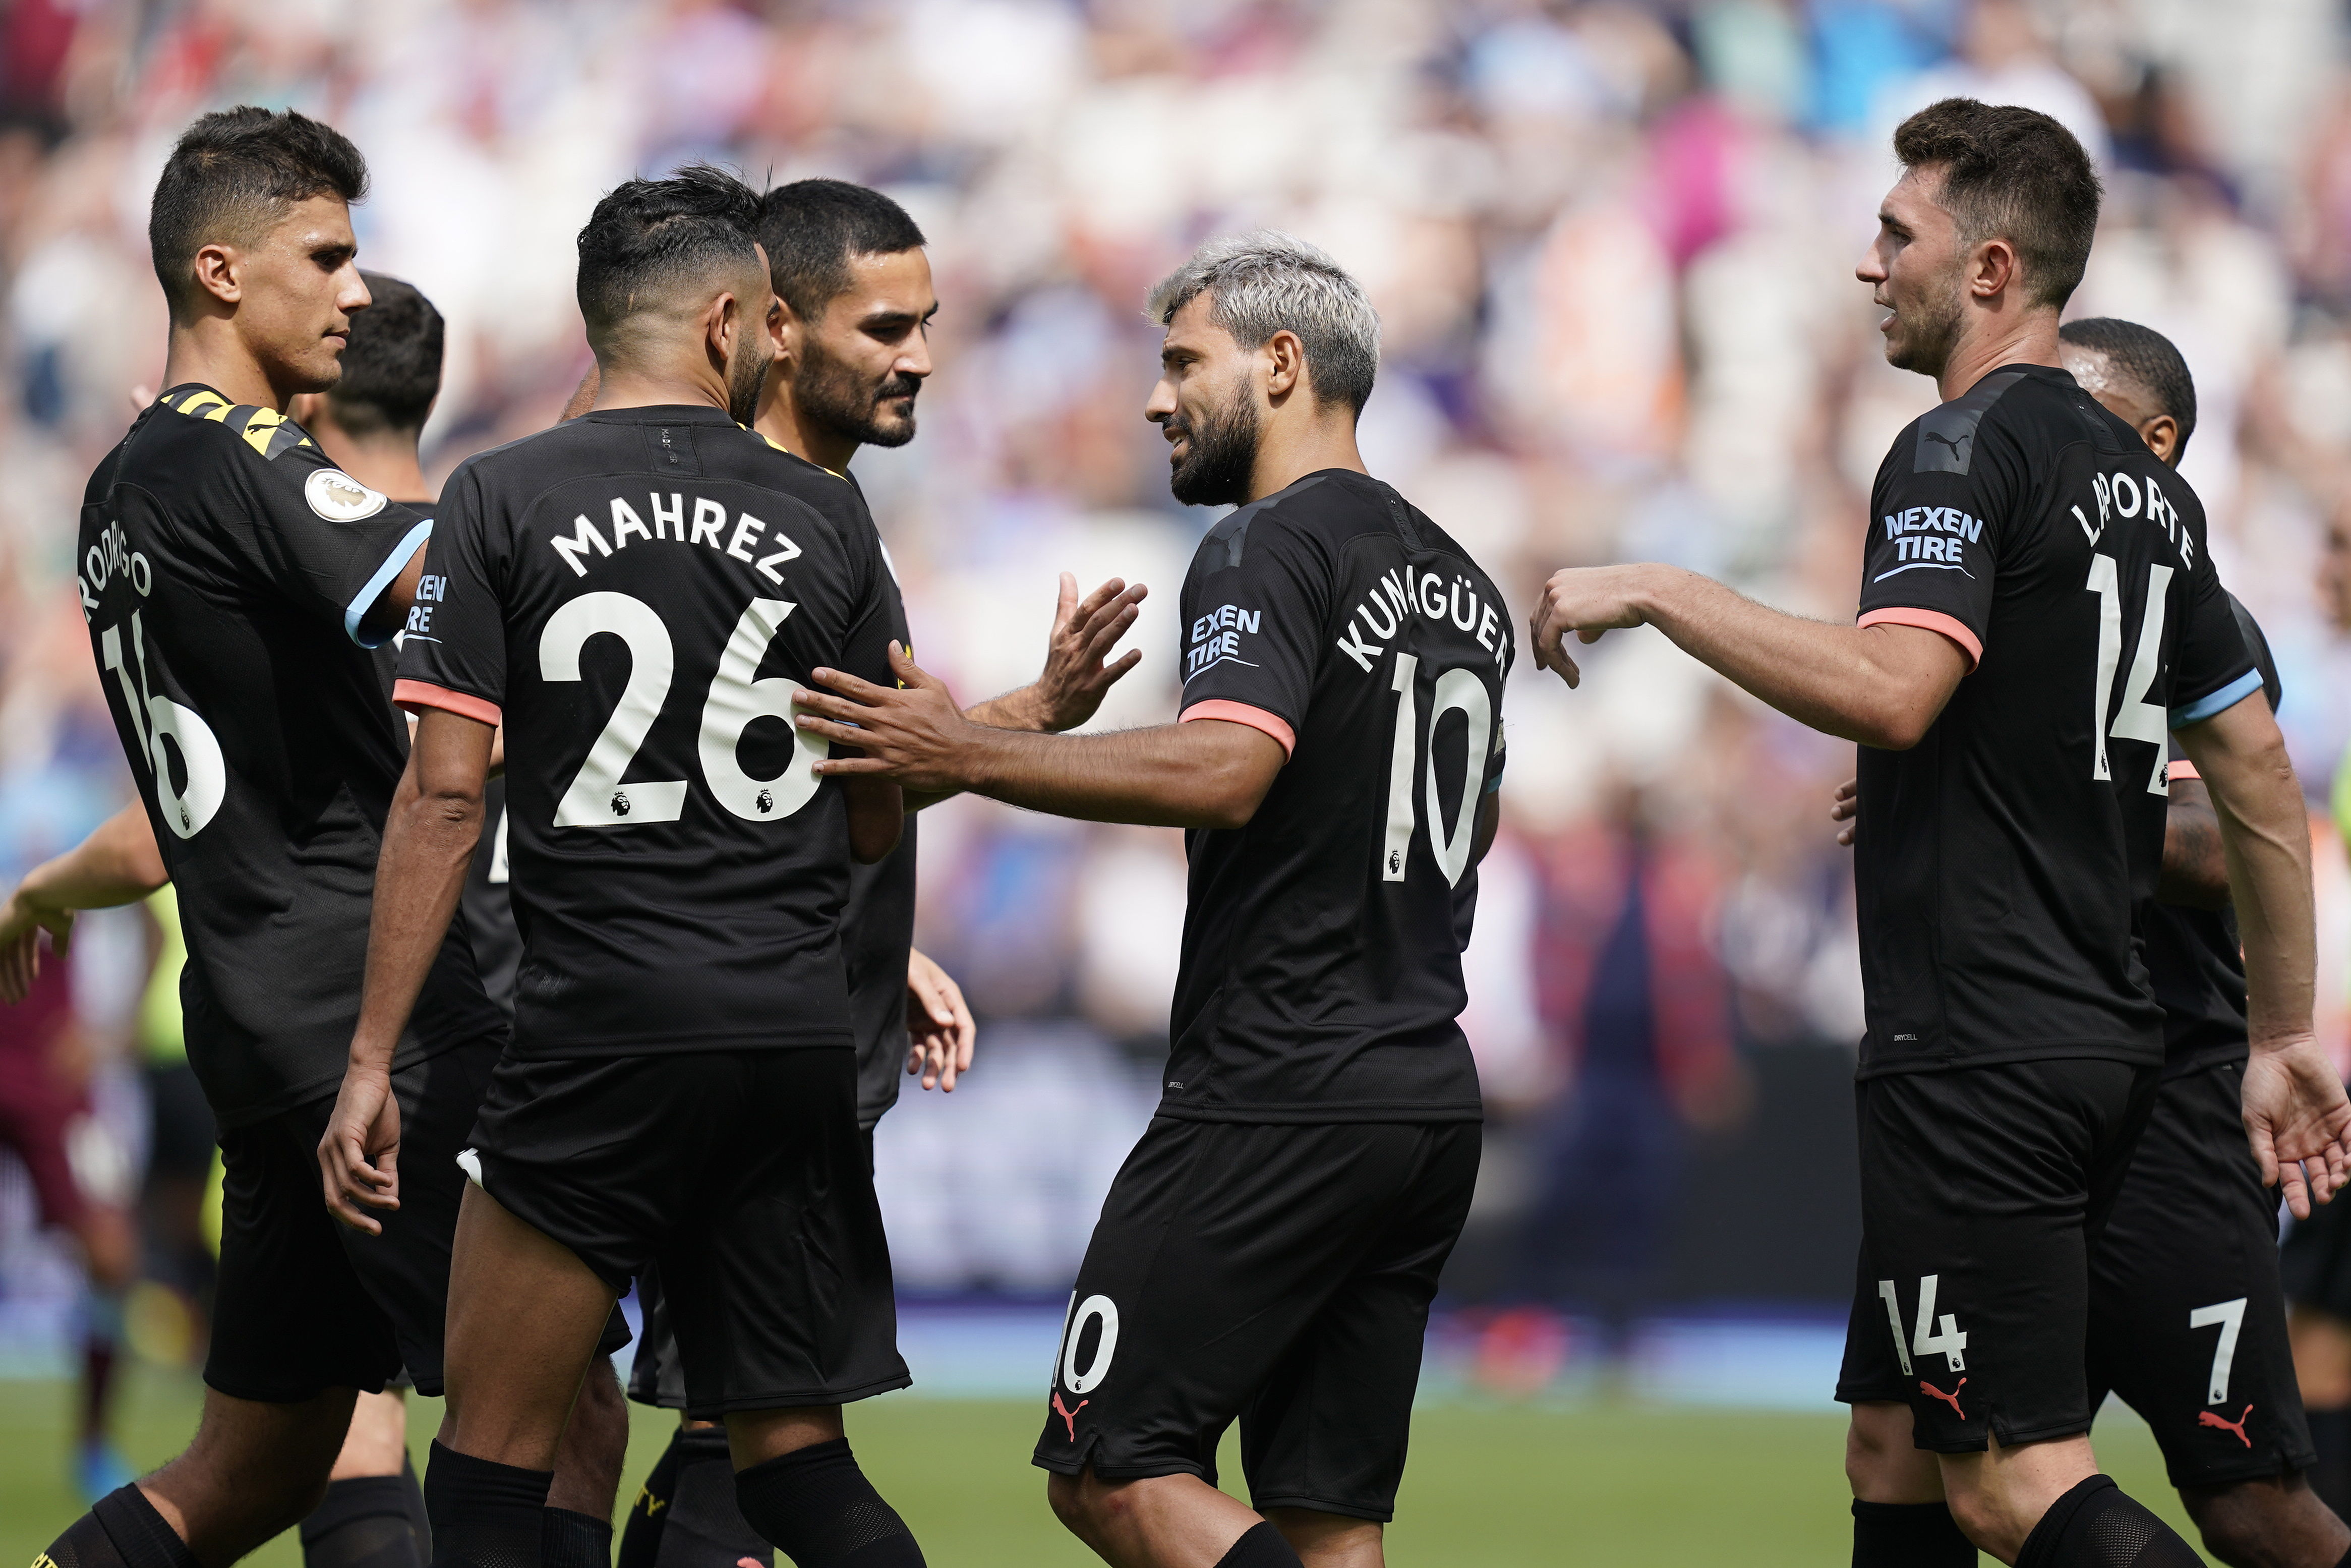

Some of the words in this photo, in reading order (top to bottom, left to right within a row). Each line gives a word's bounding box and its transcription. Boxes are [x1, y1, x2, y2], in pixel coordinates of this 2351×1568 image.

[551, 492, 802, 586] MAHREZ
[1885, 506, 1983, 544] NEXEN
[1894, 536, 1963, 564] TIRE
[2071, 472, 2194, 571] LAPORTE
[1187, 630, 1240, 673] TIRE
[1191, 604, 1261, 634] EXEN
[102, 607, 226, 839] 16
[539, 591, 830, 827] 26
[2086, 553, 2173, 797] 14
[1383, 652, 1491, 890] 10
[1878, 1274, 1967, 1376] 14
[2190, 1298, 2247, 1406] 7
